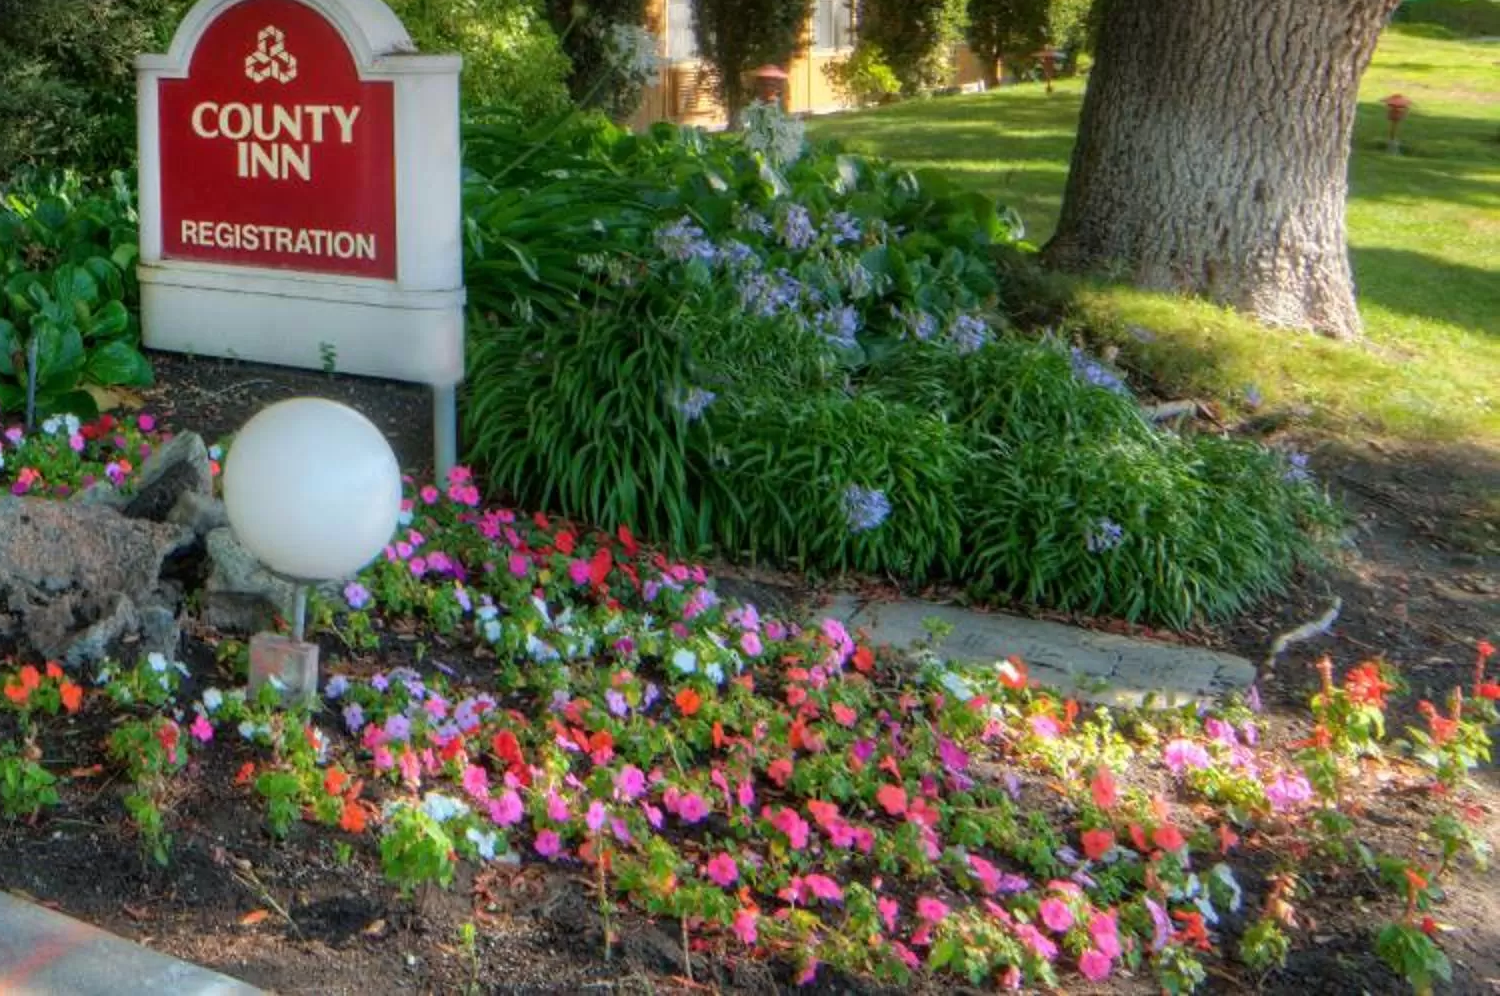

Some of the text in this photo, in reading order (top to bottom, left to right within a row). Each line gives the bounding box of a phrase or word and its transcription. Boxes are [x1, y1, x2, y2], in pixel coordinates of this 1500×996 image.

[191, 102, 360, 143] COUNTY
[238, 142, 311, 181] INN
[181, 219, 376, 260] REGISTRATION
